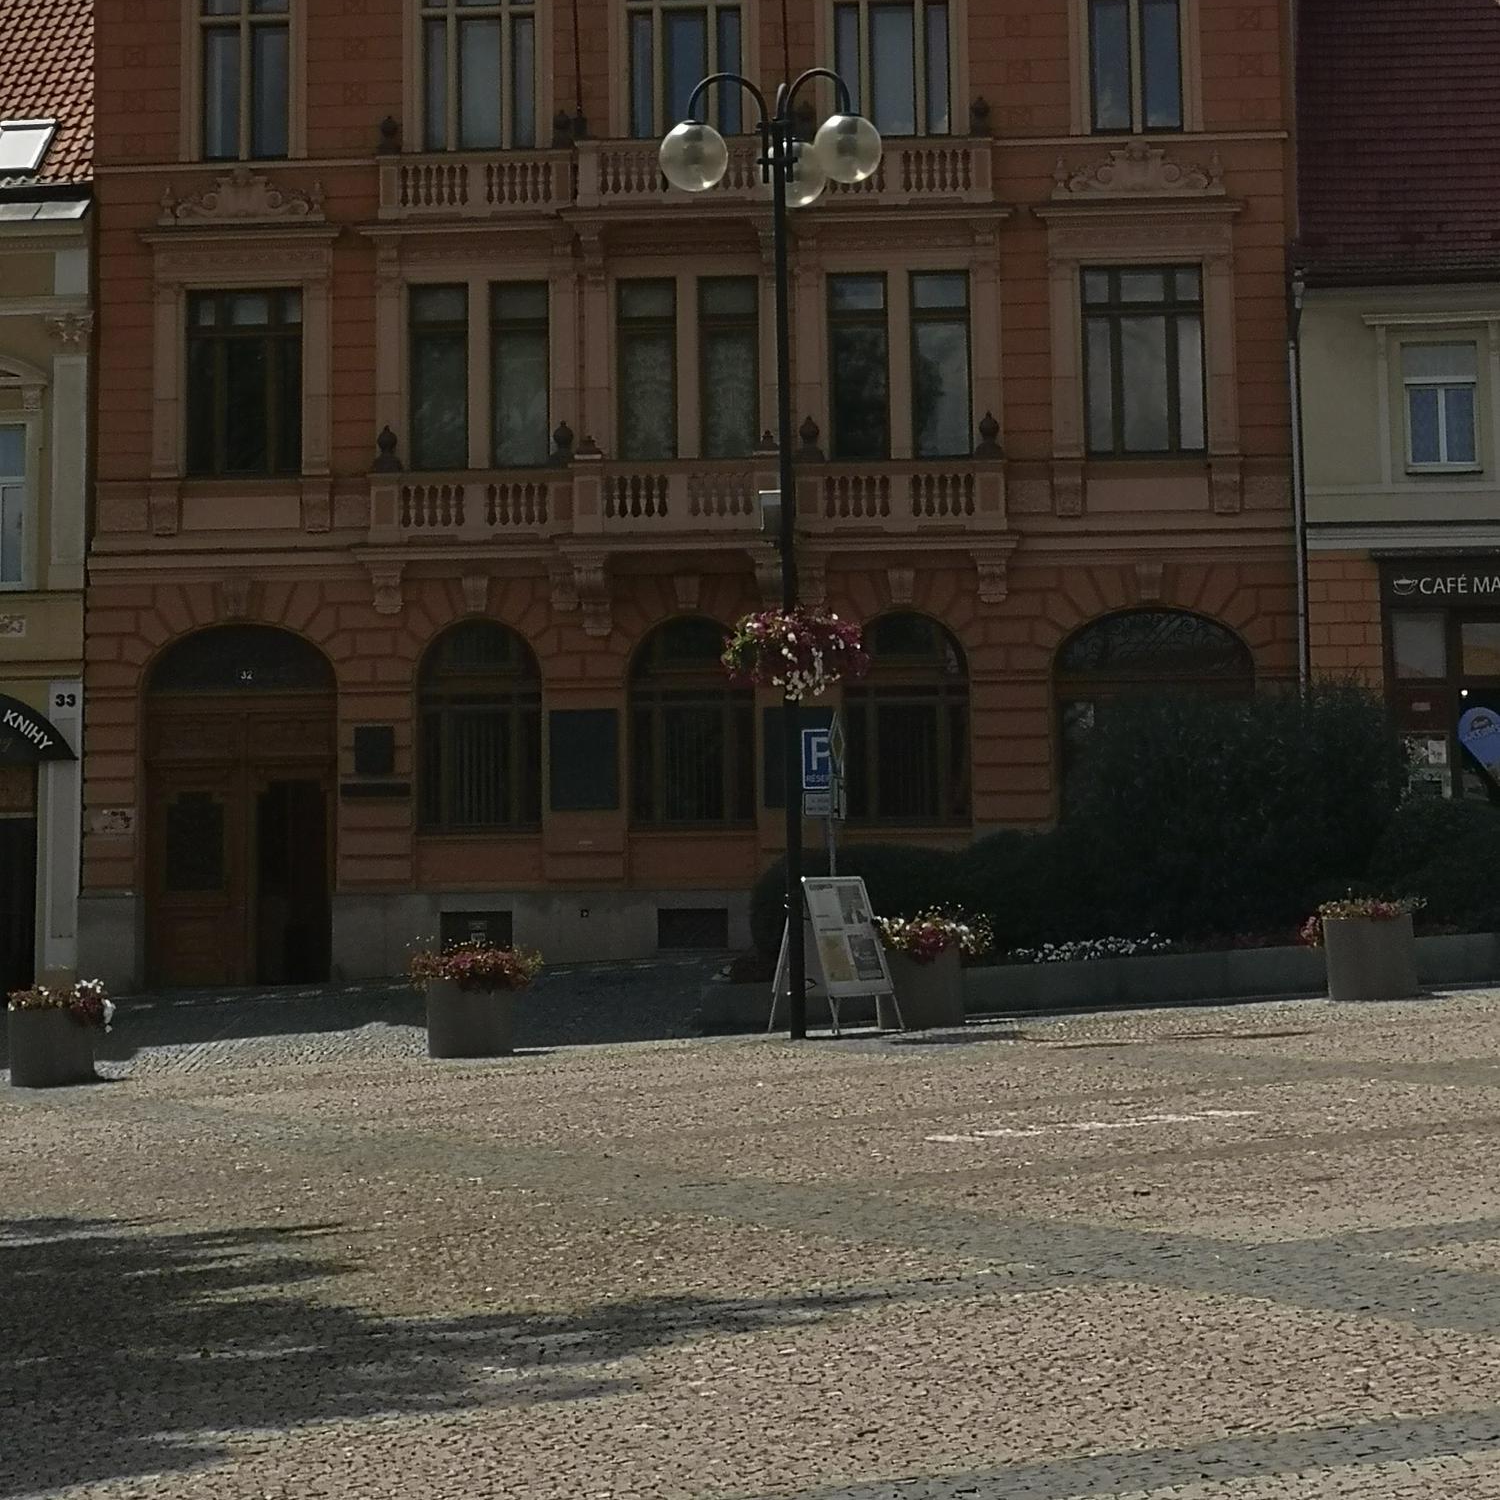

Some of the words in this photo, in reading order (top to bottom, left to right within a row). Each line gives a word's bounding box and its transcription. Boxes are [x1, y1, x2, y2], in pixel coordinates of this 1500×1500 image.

[1419, 573, 1468, 595] CAFÉ
[1473, 576, 1500, 594] MA
[55, 693, 77, 708] 33
[3, 709, 54, 750] KNIHY
[811, 737, 831, 771] P
